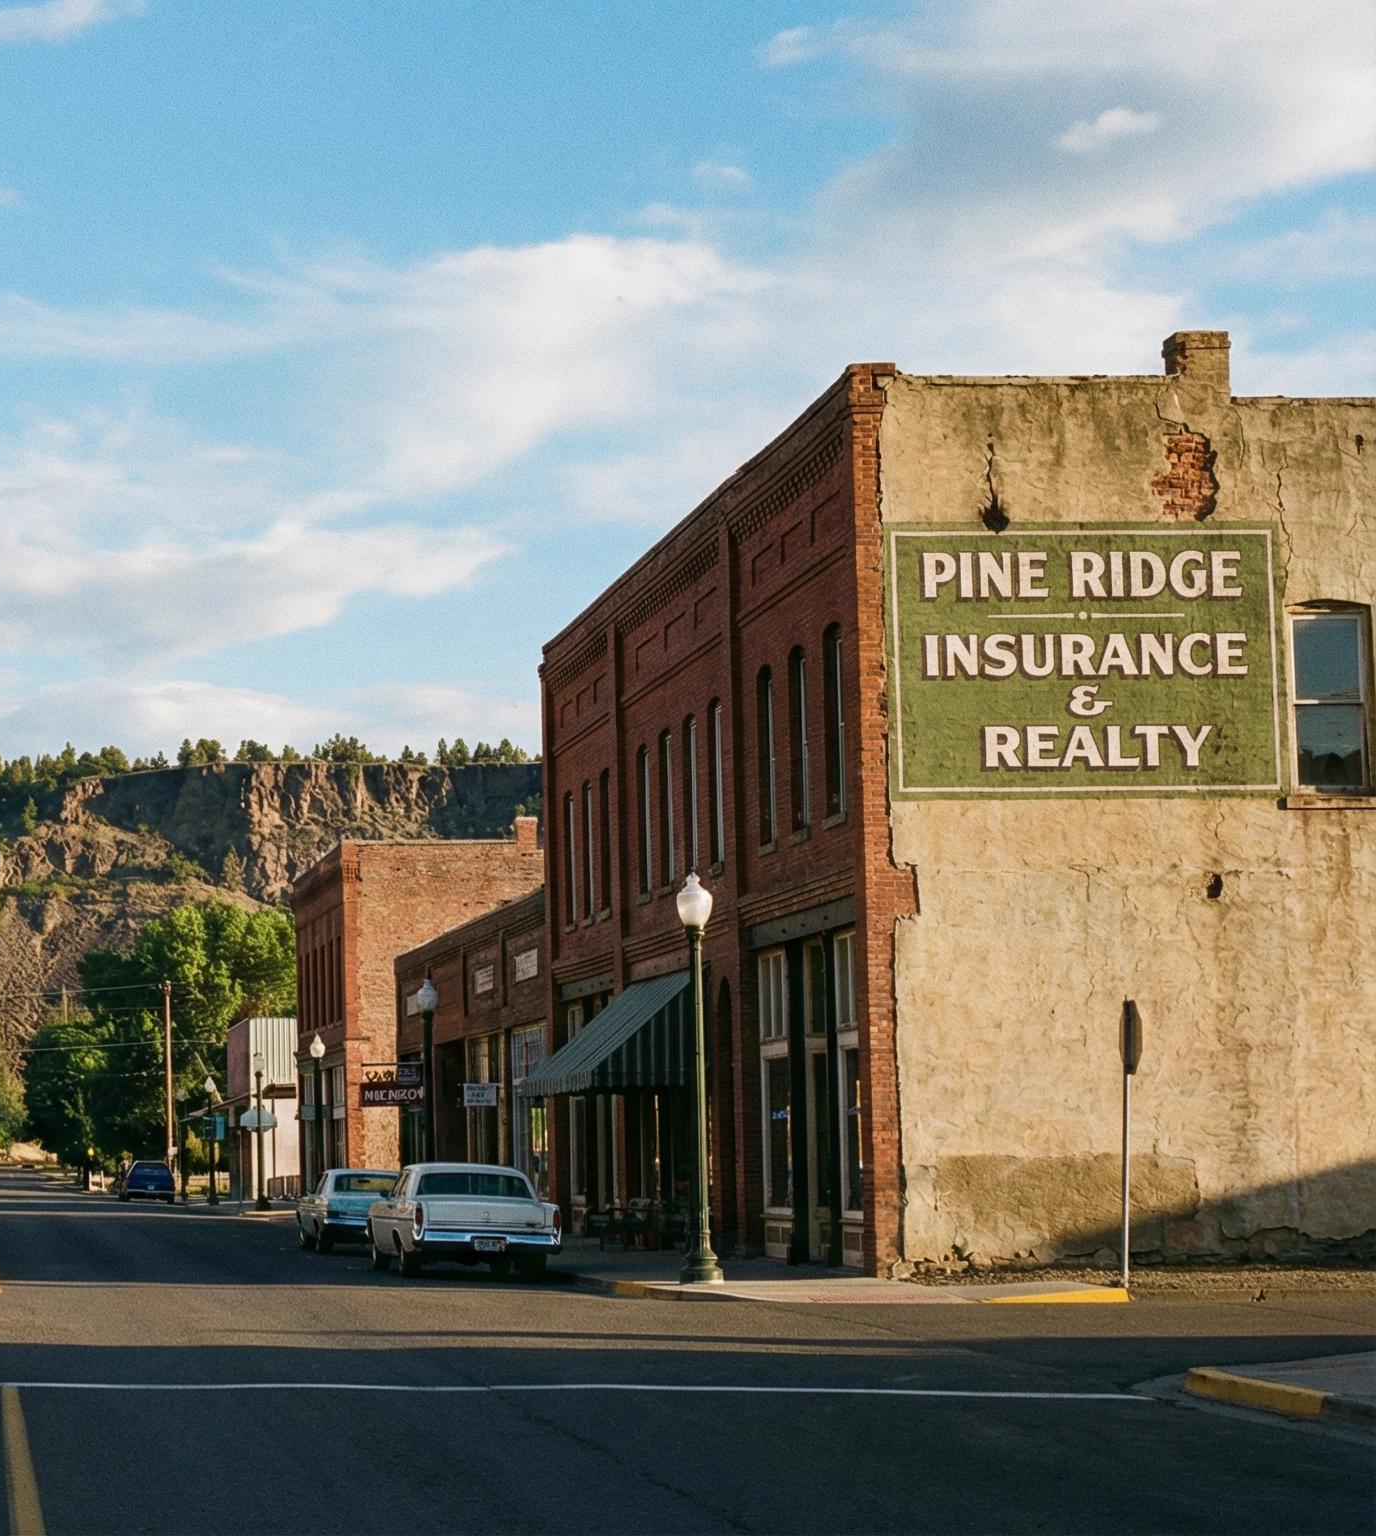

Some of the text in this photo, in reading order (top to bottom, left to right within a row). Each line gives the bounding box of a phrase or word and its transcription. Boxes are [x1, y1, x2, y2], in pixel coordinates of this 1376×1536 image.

[921, 550, 1243, 599] PINE RIDGE
[923, 632, 1249, 678] INSURANCE
[1068, 685, 1113, 717] &
[983, 725, 1213, 769] REALTY
